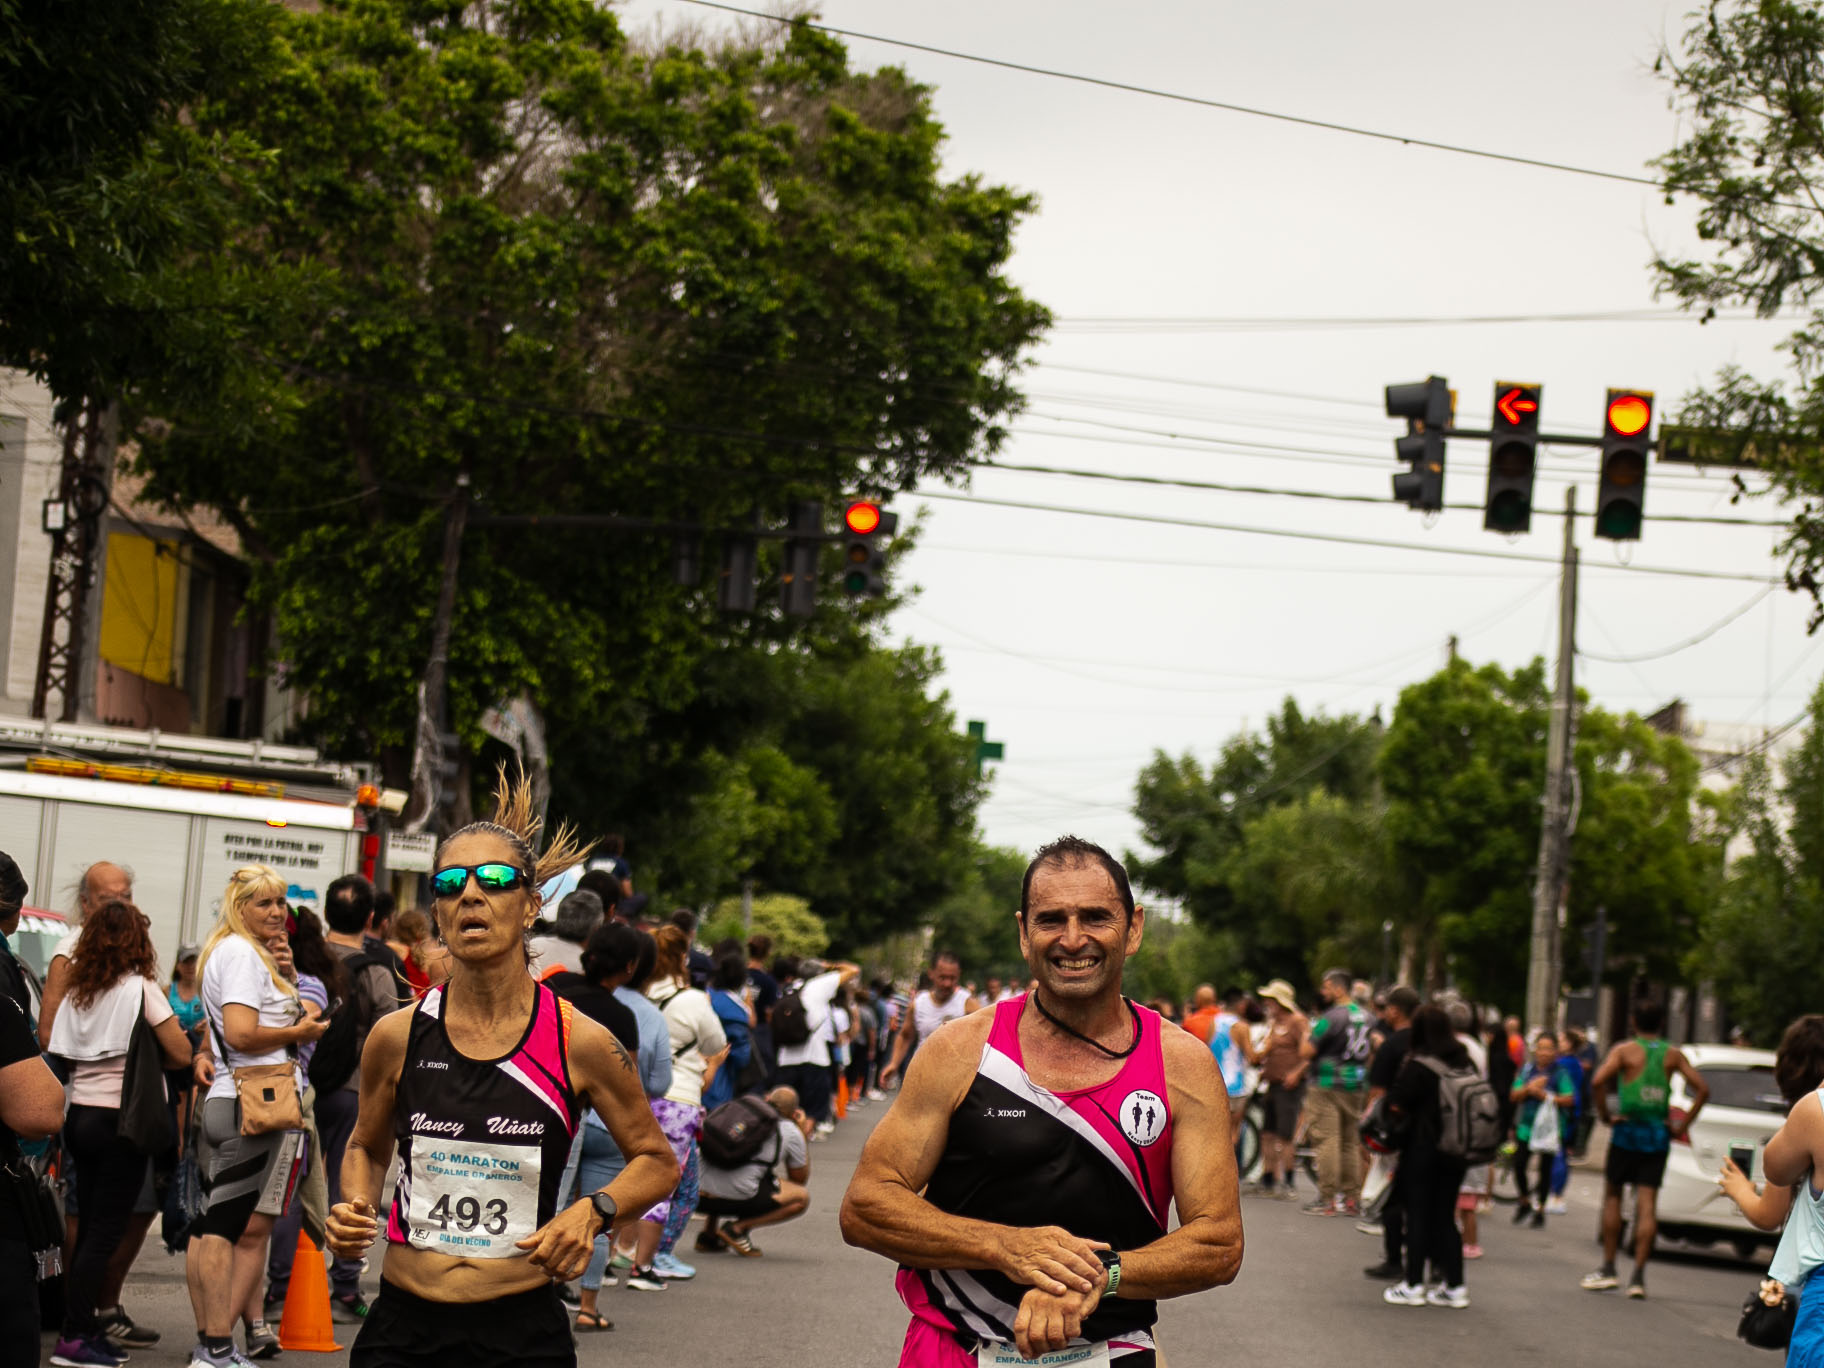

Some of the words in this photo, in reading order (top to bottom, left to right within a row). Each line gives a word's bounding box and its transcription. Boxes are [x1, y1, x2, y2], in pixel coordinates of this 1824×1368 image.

[1135, 1092, 1156, 1102] Team
[410, 1112, 465, 1137] Nancy
[486, 1116, 545, 1135] Uñate
[430, 1151, 446, 1162] 40
[450, 1153, 520, 1171] MARATON
[426, 1164, 470, 1177] EMPALME
[471, 1171, 523, 1182] GRANEROS
[428, 1193, 508, 1236] 493
[439, 1233, 451, 1244] DIA
[451, 1234, 464, 1245] DEL
[465, 1236, 491, 1247] VECINO
[1041, 1350, 1092, 1364] GRANEROS
